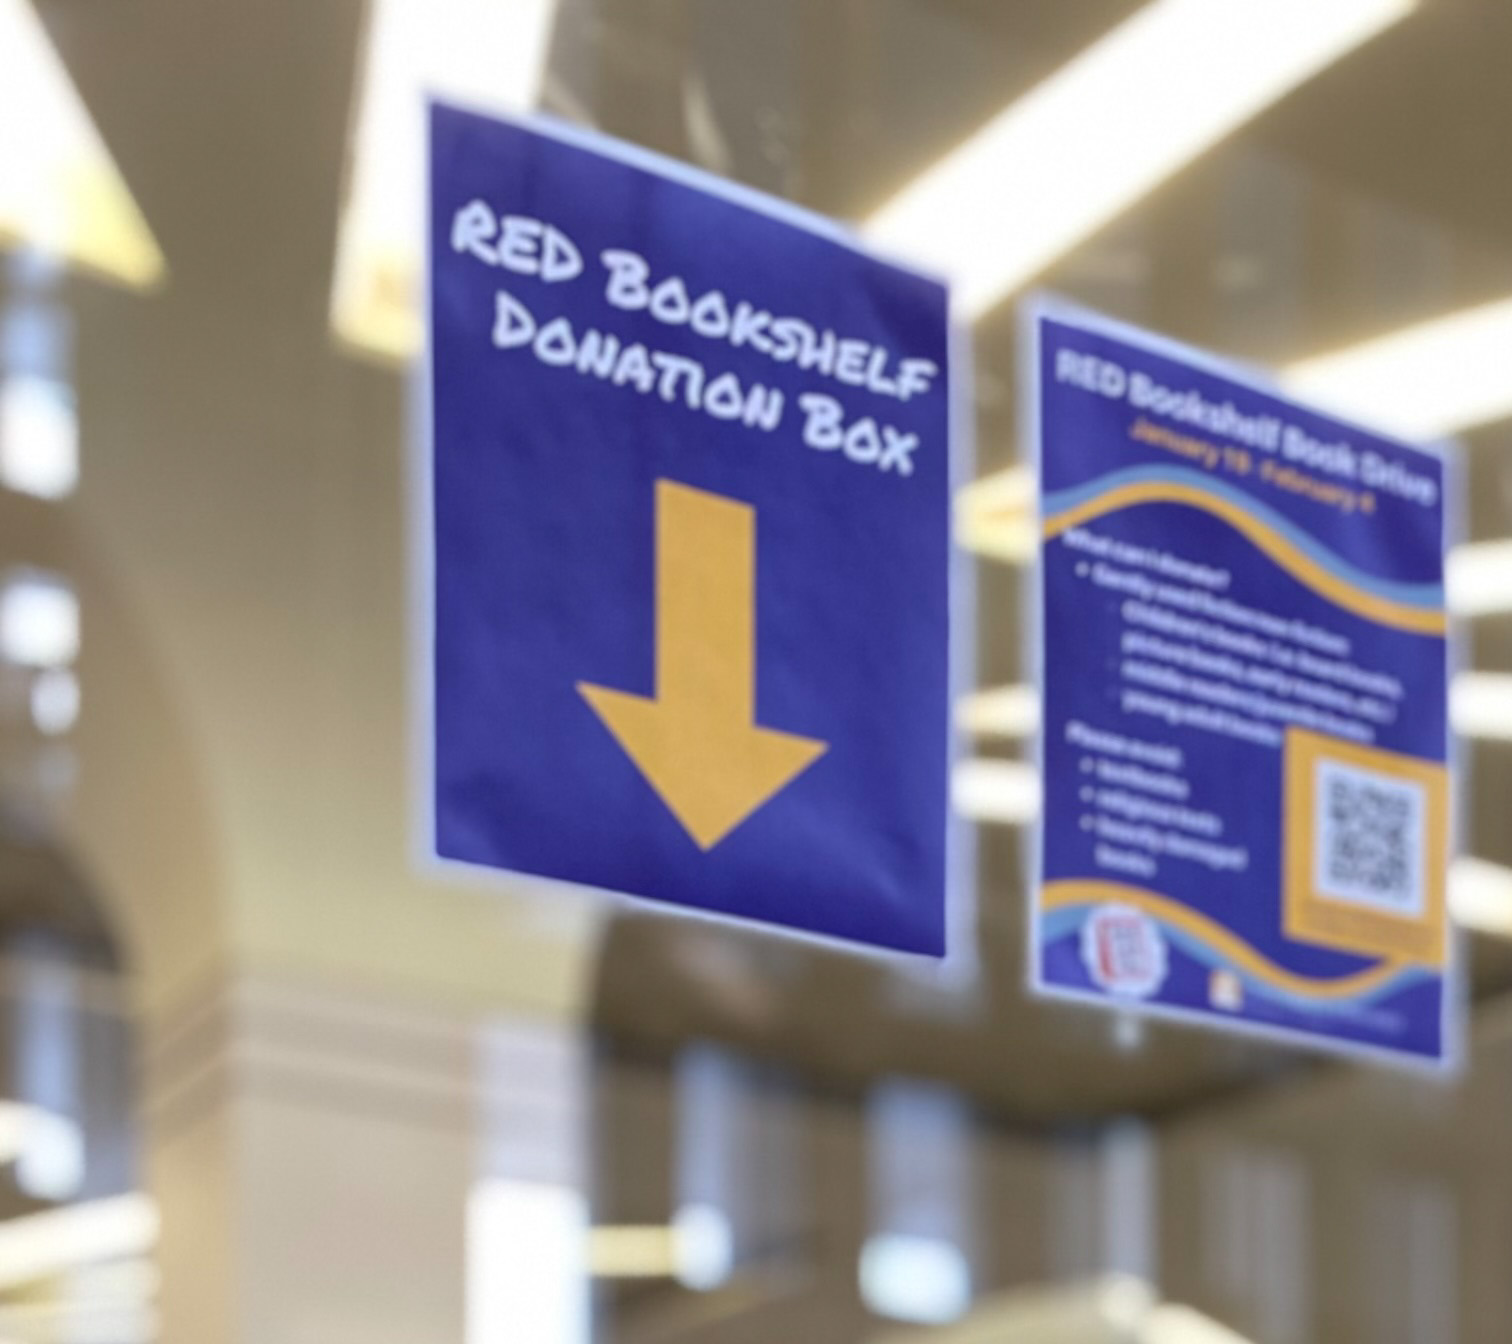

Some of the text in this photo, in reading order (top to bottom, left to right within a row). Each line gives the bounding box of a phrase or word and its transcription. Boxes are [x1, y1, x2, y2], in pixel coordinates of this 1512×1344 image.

[451, 199, 938, 401] RED BOOKSHELF
[492, 292, 919, 477] DONATION BOX
